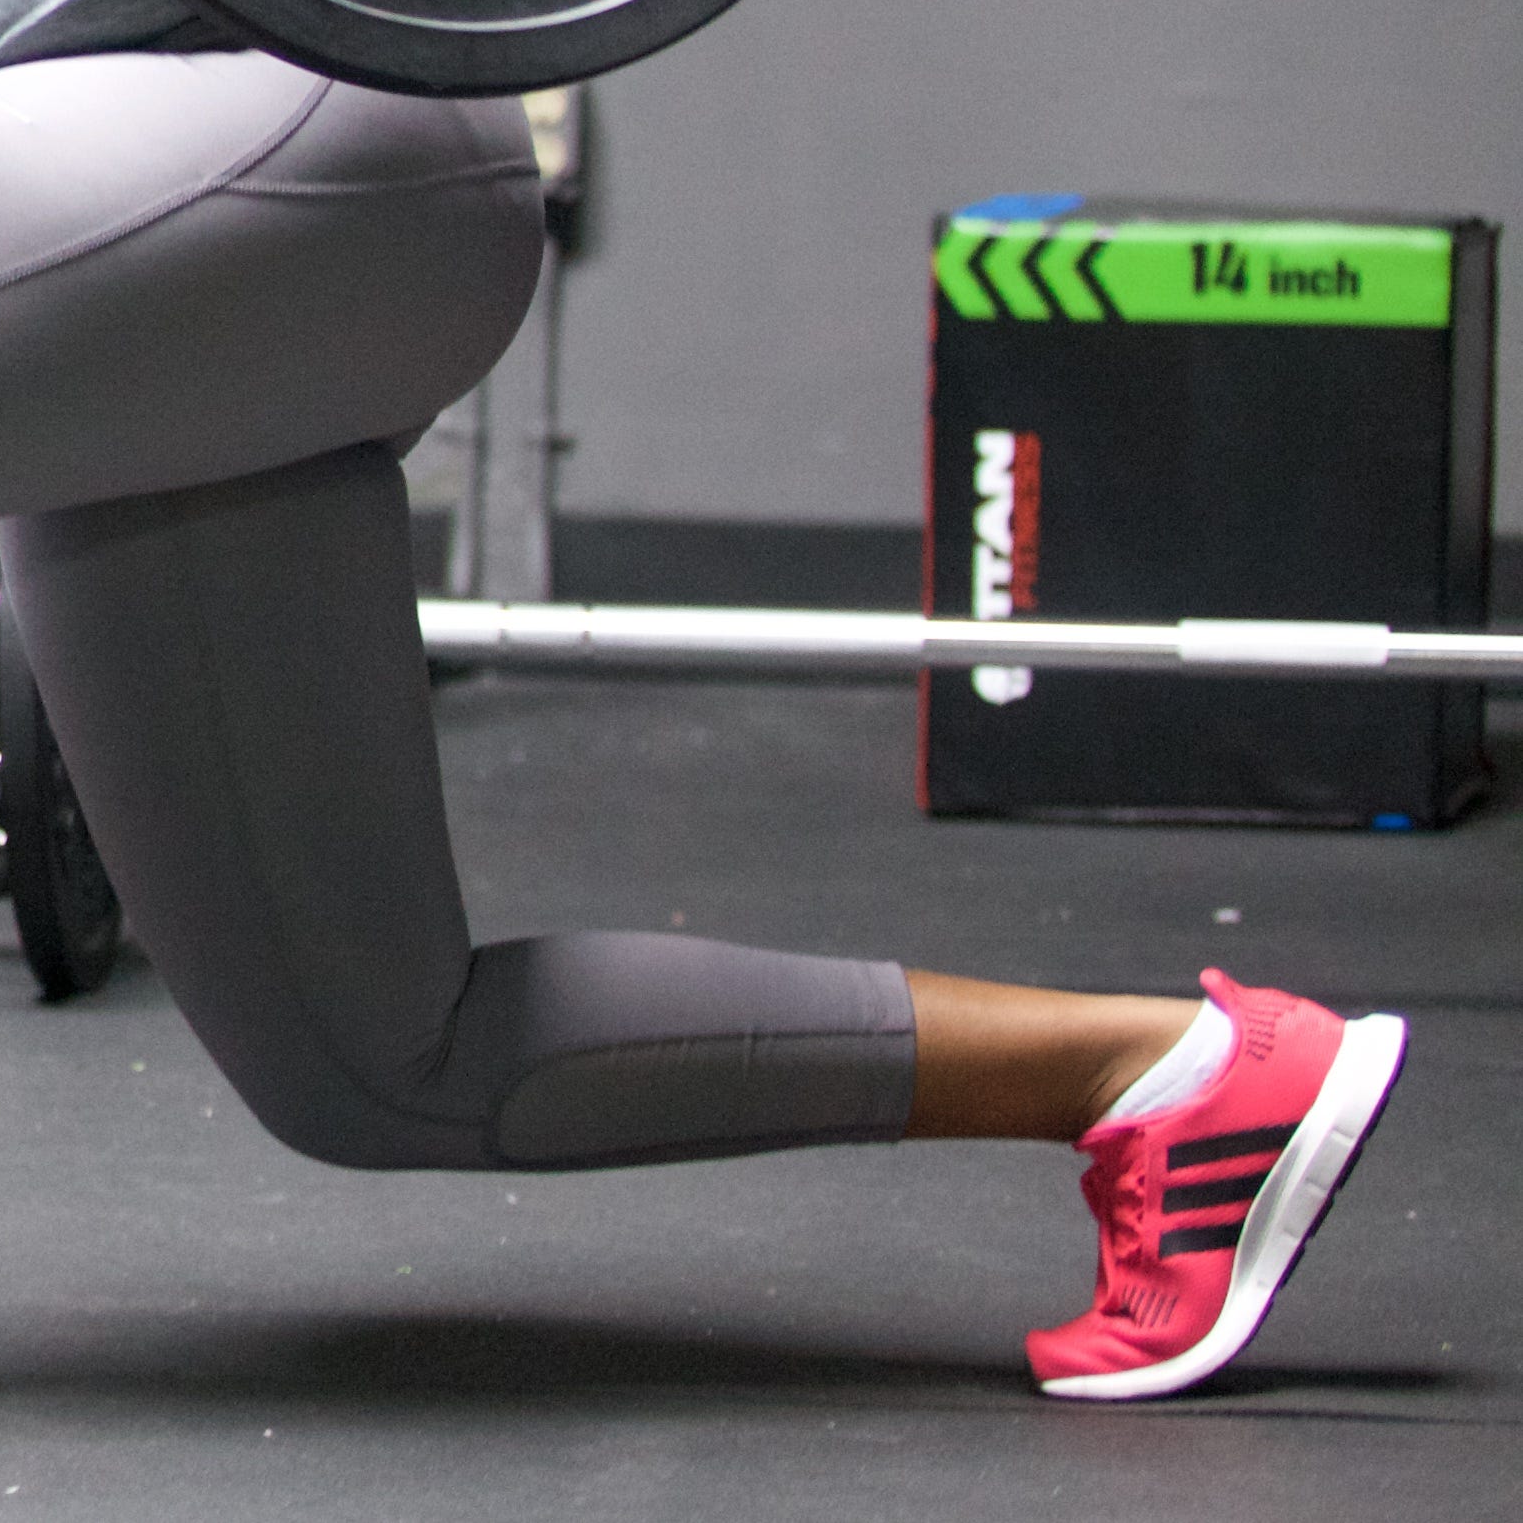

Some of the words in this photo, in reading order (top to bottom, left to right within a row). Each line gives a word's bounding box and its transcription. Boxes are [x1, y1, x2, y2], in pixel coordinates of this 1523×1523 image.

[1190, 240, 1250, 295] 14
[1268, 256, 1363, 299] inch
[971, 428, 1016, 620] ITAN
